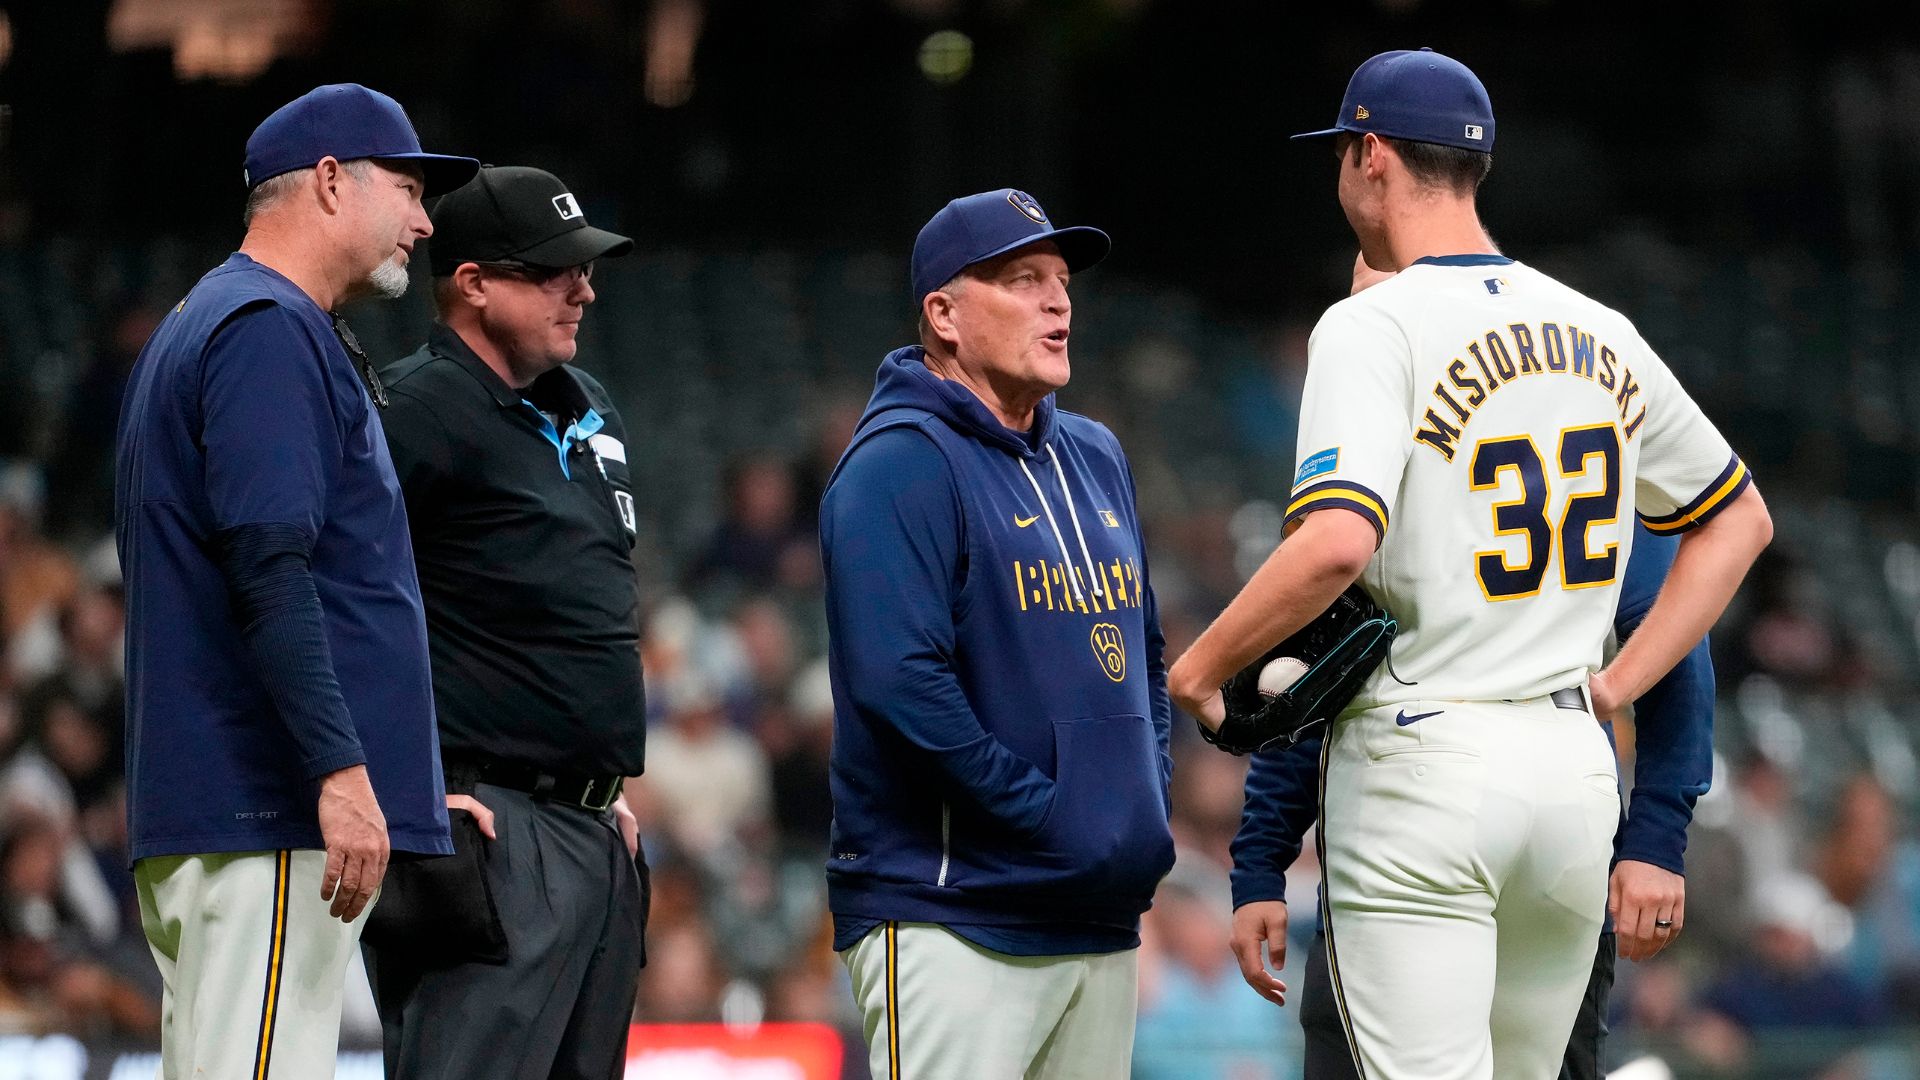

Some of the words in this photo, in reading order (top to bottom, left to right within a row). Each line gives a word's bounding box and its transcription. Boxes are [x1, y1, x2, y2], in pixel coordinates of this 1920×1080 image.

[1414, 321, 1647, 463] MISIOROWSKI
[1469, 422, 1621, 601] 32
[235, 811, 279, 820] DRI-FIT
